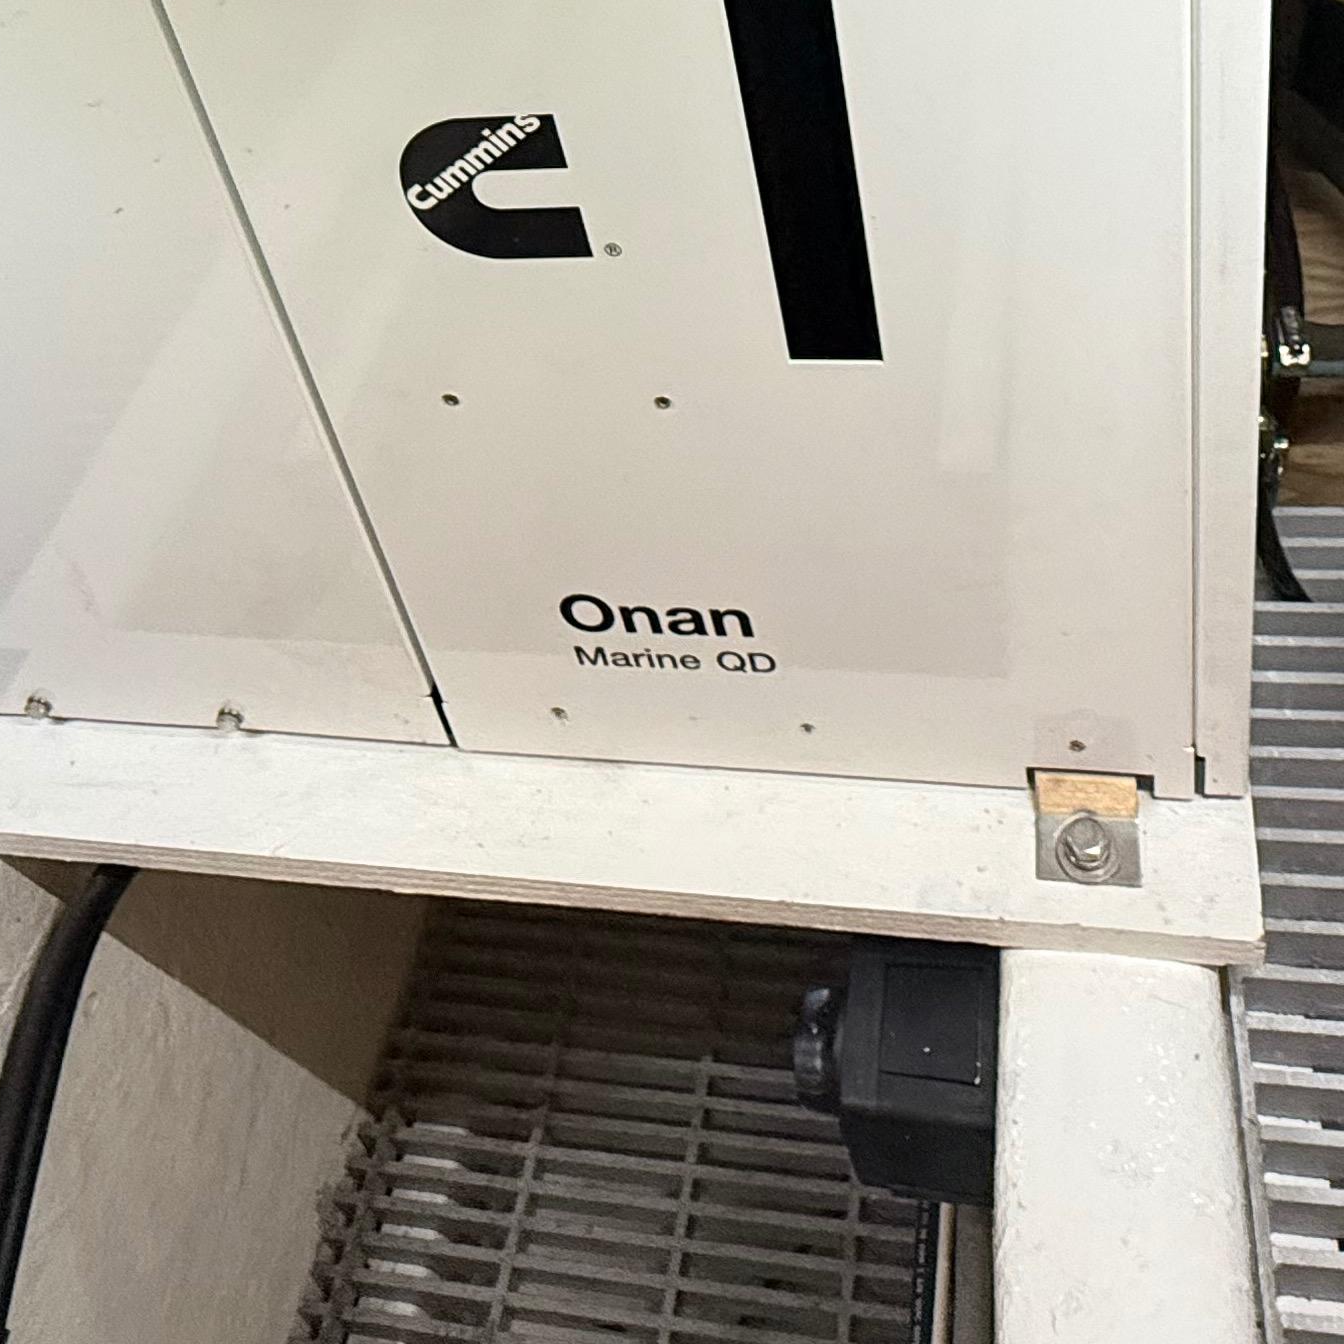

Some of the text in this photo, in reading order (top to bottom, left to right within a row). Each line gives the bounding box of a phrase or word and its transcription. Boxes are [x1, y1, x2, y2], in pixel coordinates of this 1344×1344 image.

[406, 112, 540, 211] Cummins
[558, 592, 755, 637] Onan
[573, 645, 776, 675] Marine QD
